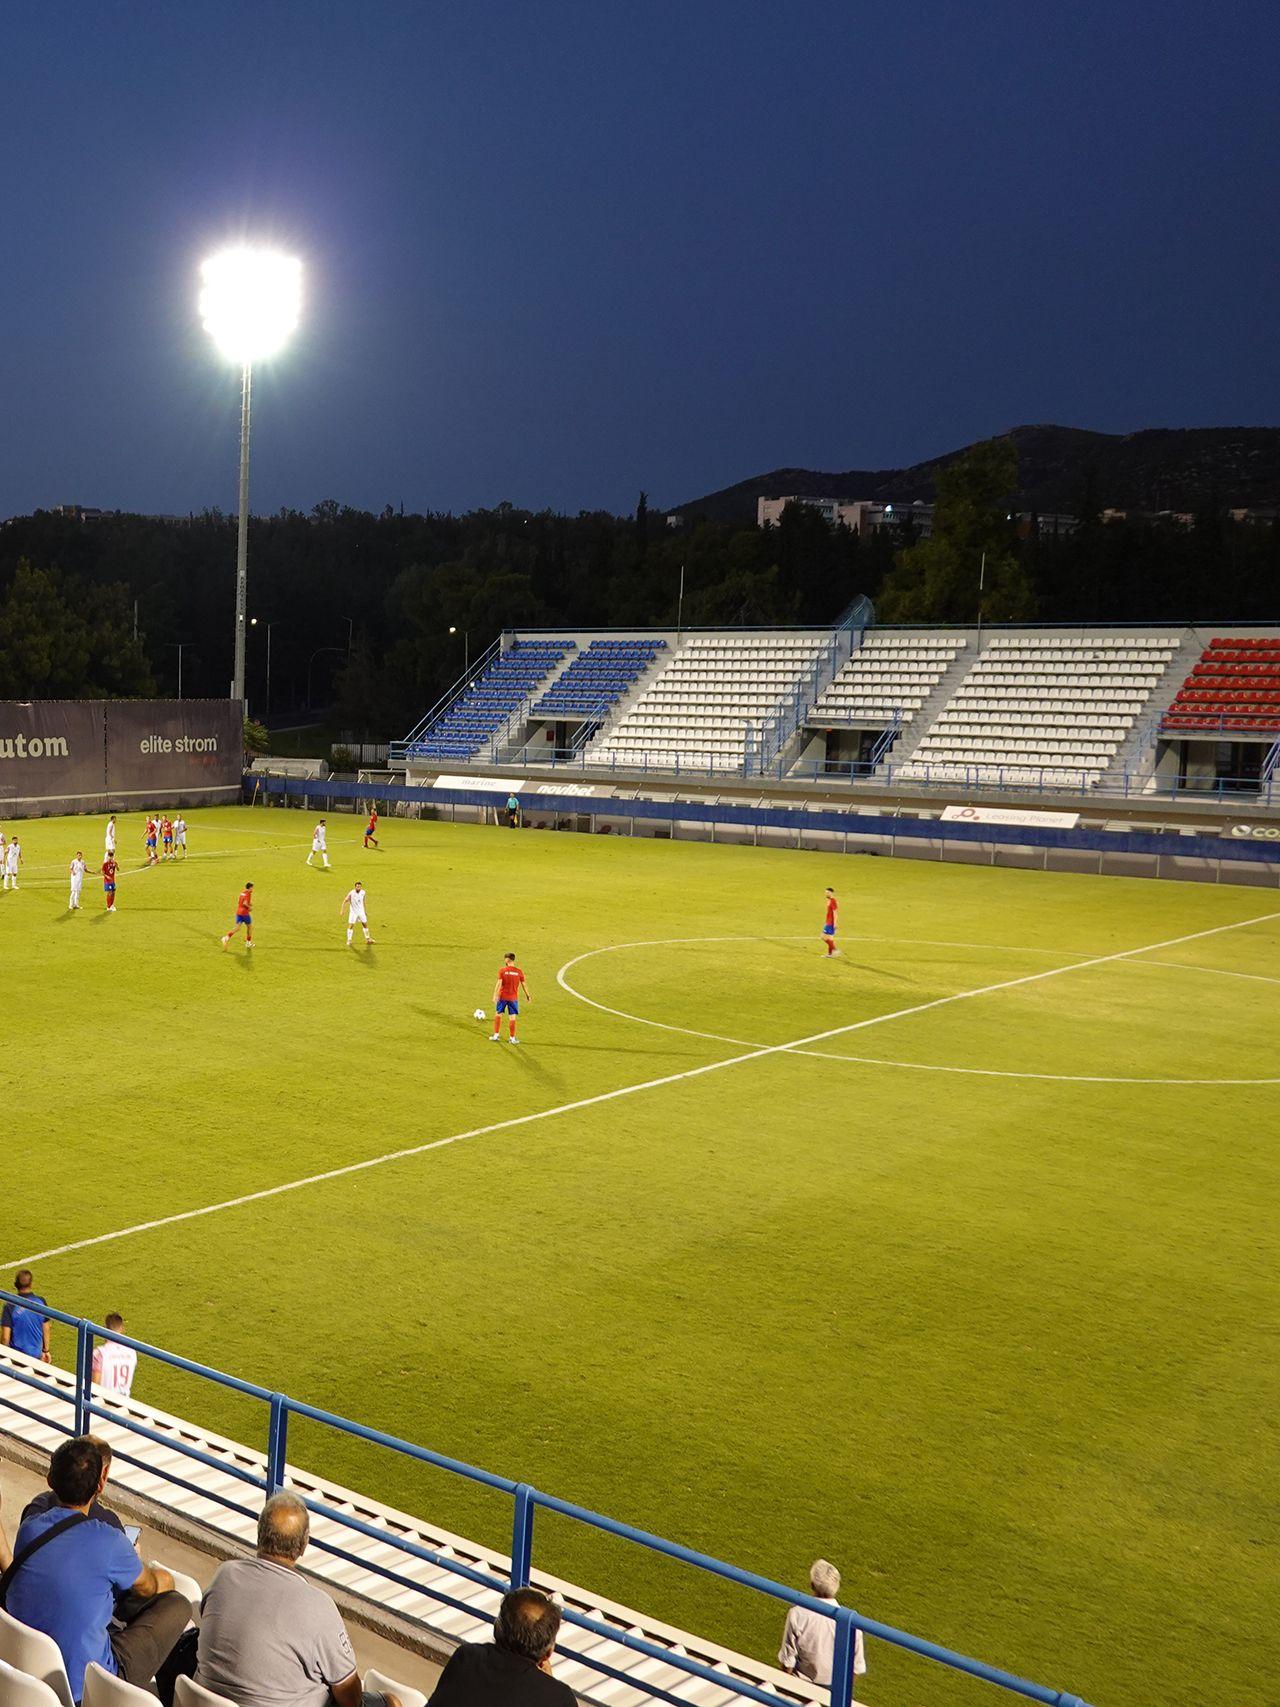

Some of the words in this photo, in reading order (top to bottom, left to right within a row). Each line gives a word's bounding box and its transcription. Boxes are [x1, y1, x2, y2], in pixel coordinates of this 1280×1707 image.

[140, 735, 172, 754] elite
[175, 735, 218, 753] strom
[536, 783, 596, 797] novibet
[113, 1364, 130, 1388] 19
